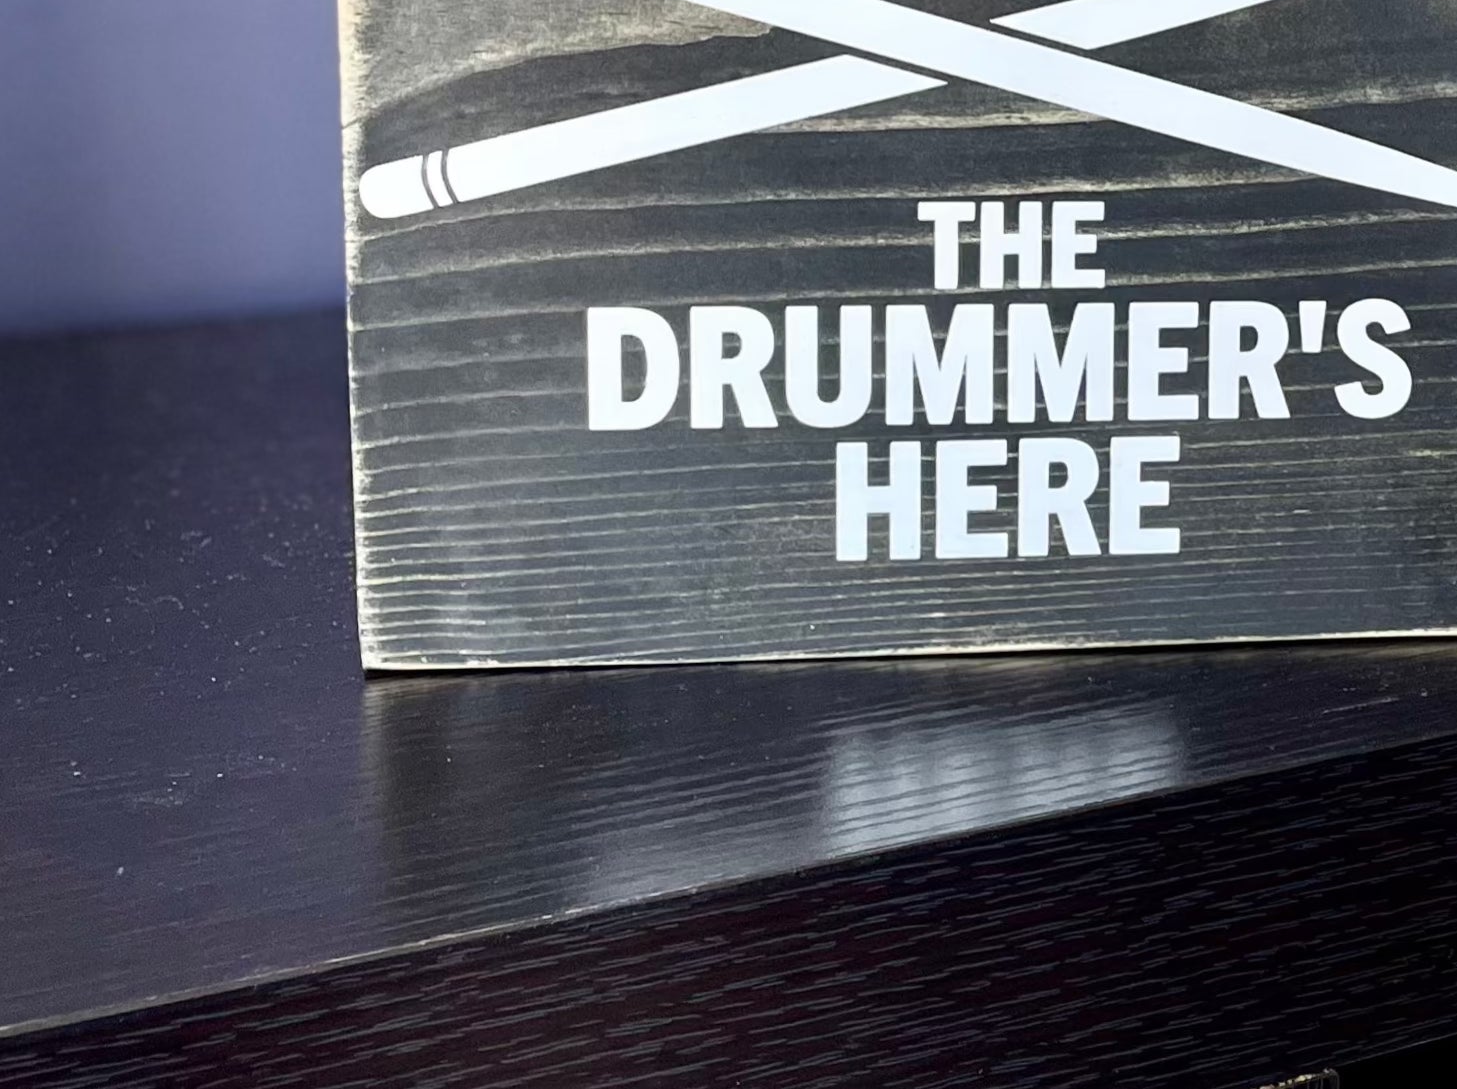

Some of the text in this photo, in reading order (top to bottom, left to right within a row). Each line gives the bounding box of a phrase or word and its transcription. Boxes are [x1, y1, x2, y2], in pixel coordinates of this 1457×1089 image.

[917, 201, 1106, 290] THE
[586, 298, 1413, 431] DRUMMER'S
[835, 435, 1181, 562] HERE
